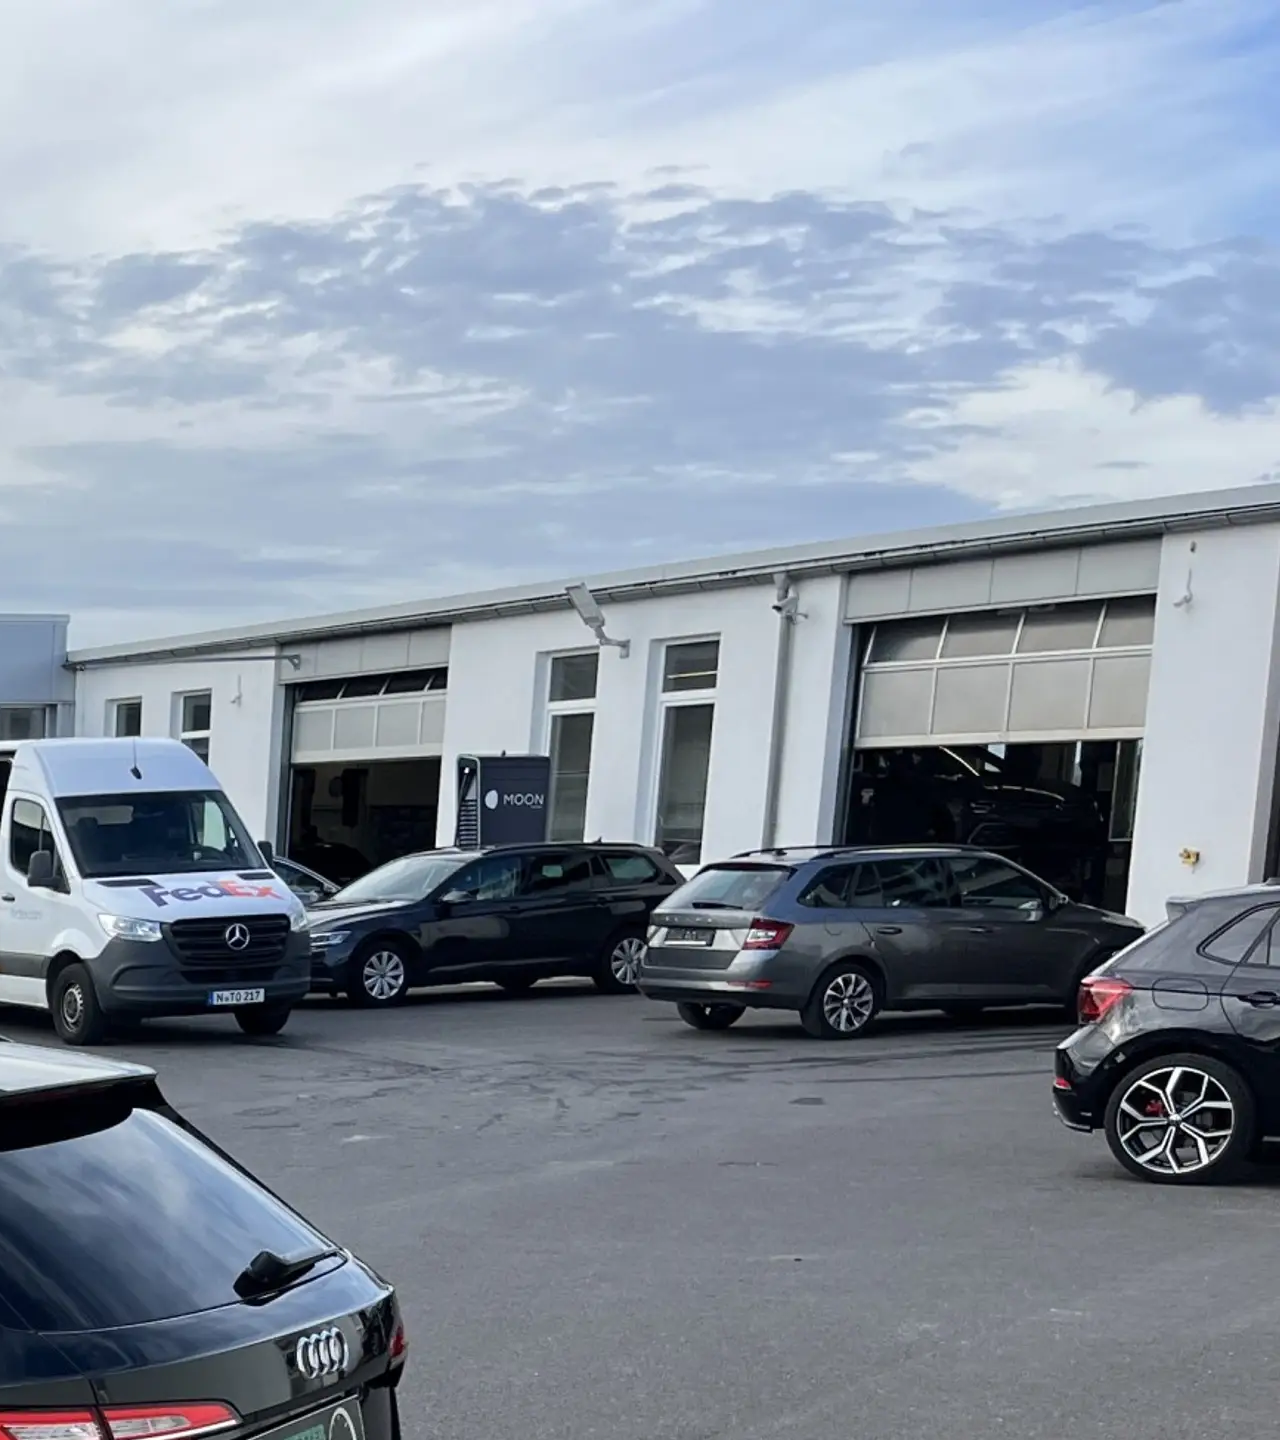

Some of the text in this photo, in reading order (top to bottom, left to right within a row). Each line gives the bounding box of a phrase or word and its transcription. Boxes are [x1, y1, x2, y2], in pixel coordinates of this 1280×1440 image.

[503, 793, 544, 806] MOON
[138, 879, 284, 907] FedEx
[244, 990, 261, 1001] 217
